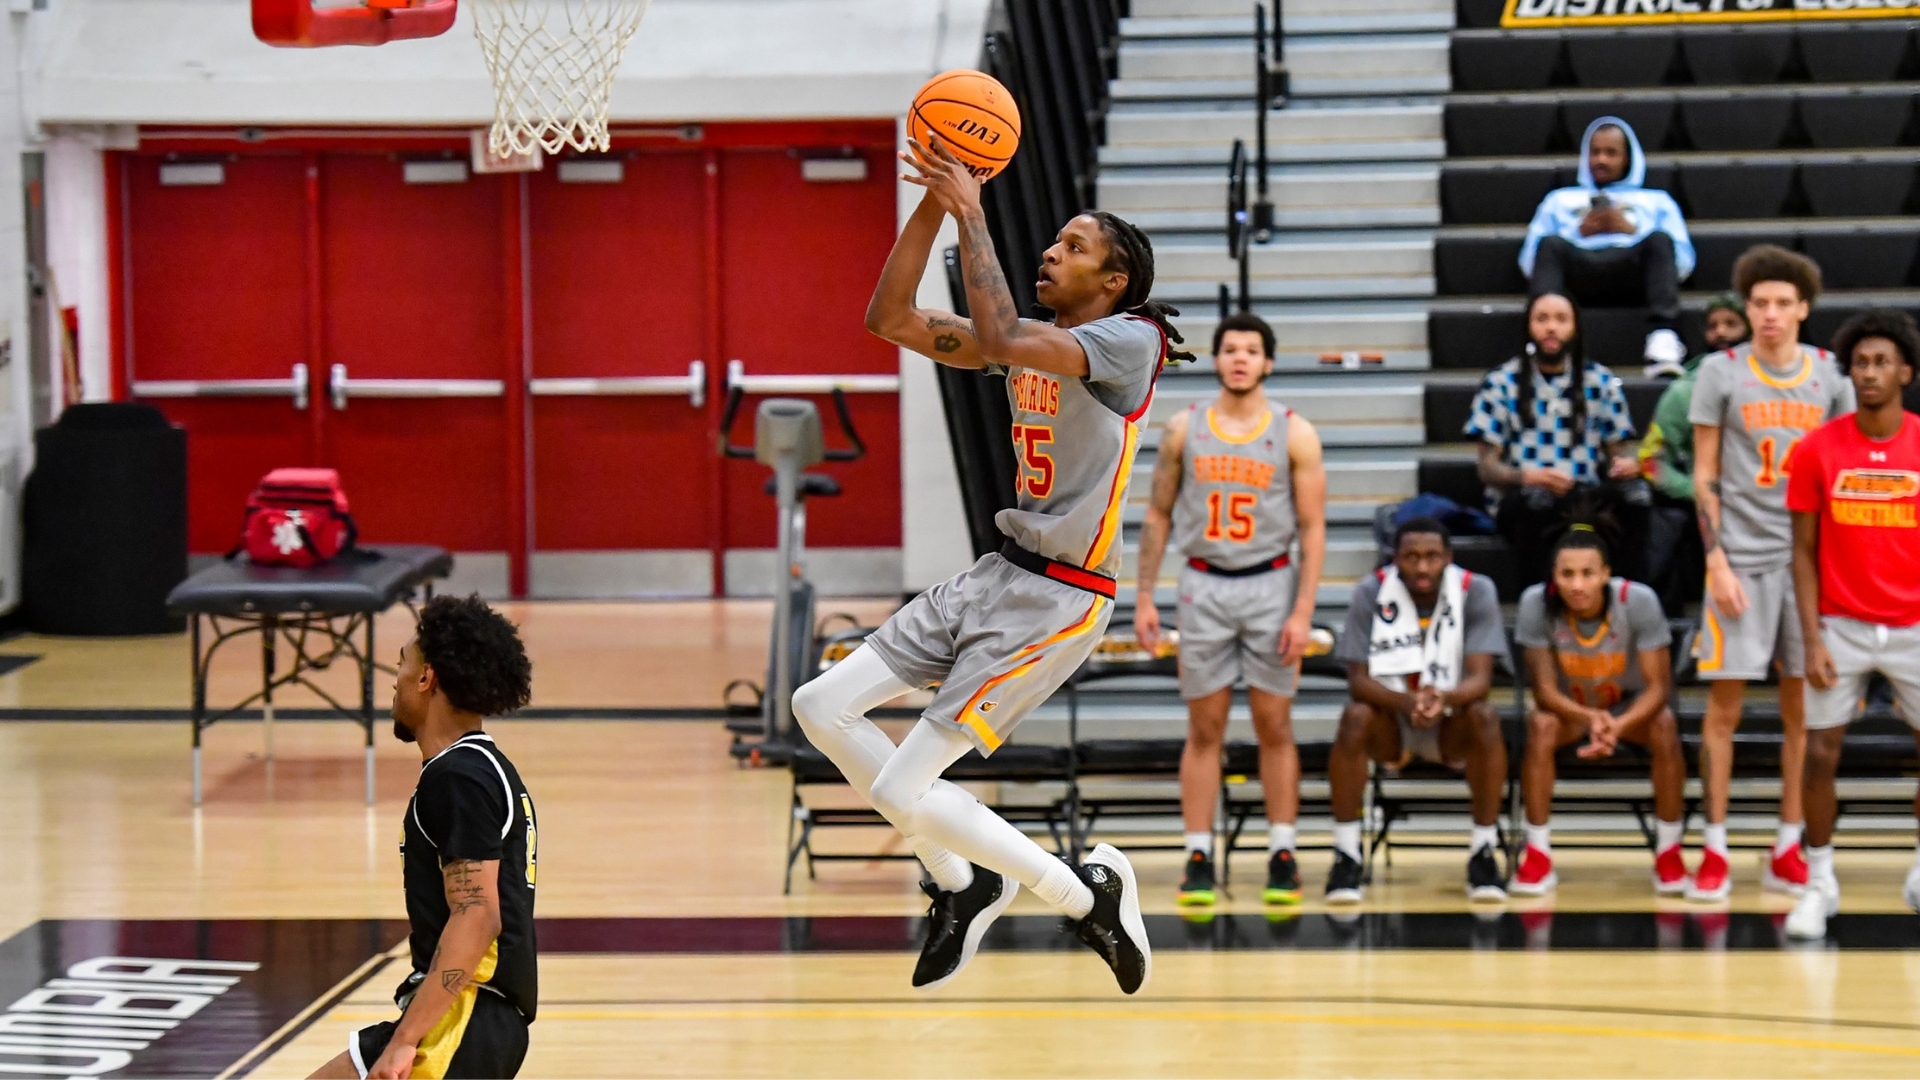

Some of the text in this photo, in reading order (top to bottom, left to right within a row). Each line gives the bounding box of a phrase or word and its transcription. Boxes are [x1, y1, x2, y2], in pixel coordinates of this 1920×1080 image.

[956, 118, 1001, 146] EVO
[1204, 489, 1257, 543] 15
[0, 956, 262, 1080] UMBIA
